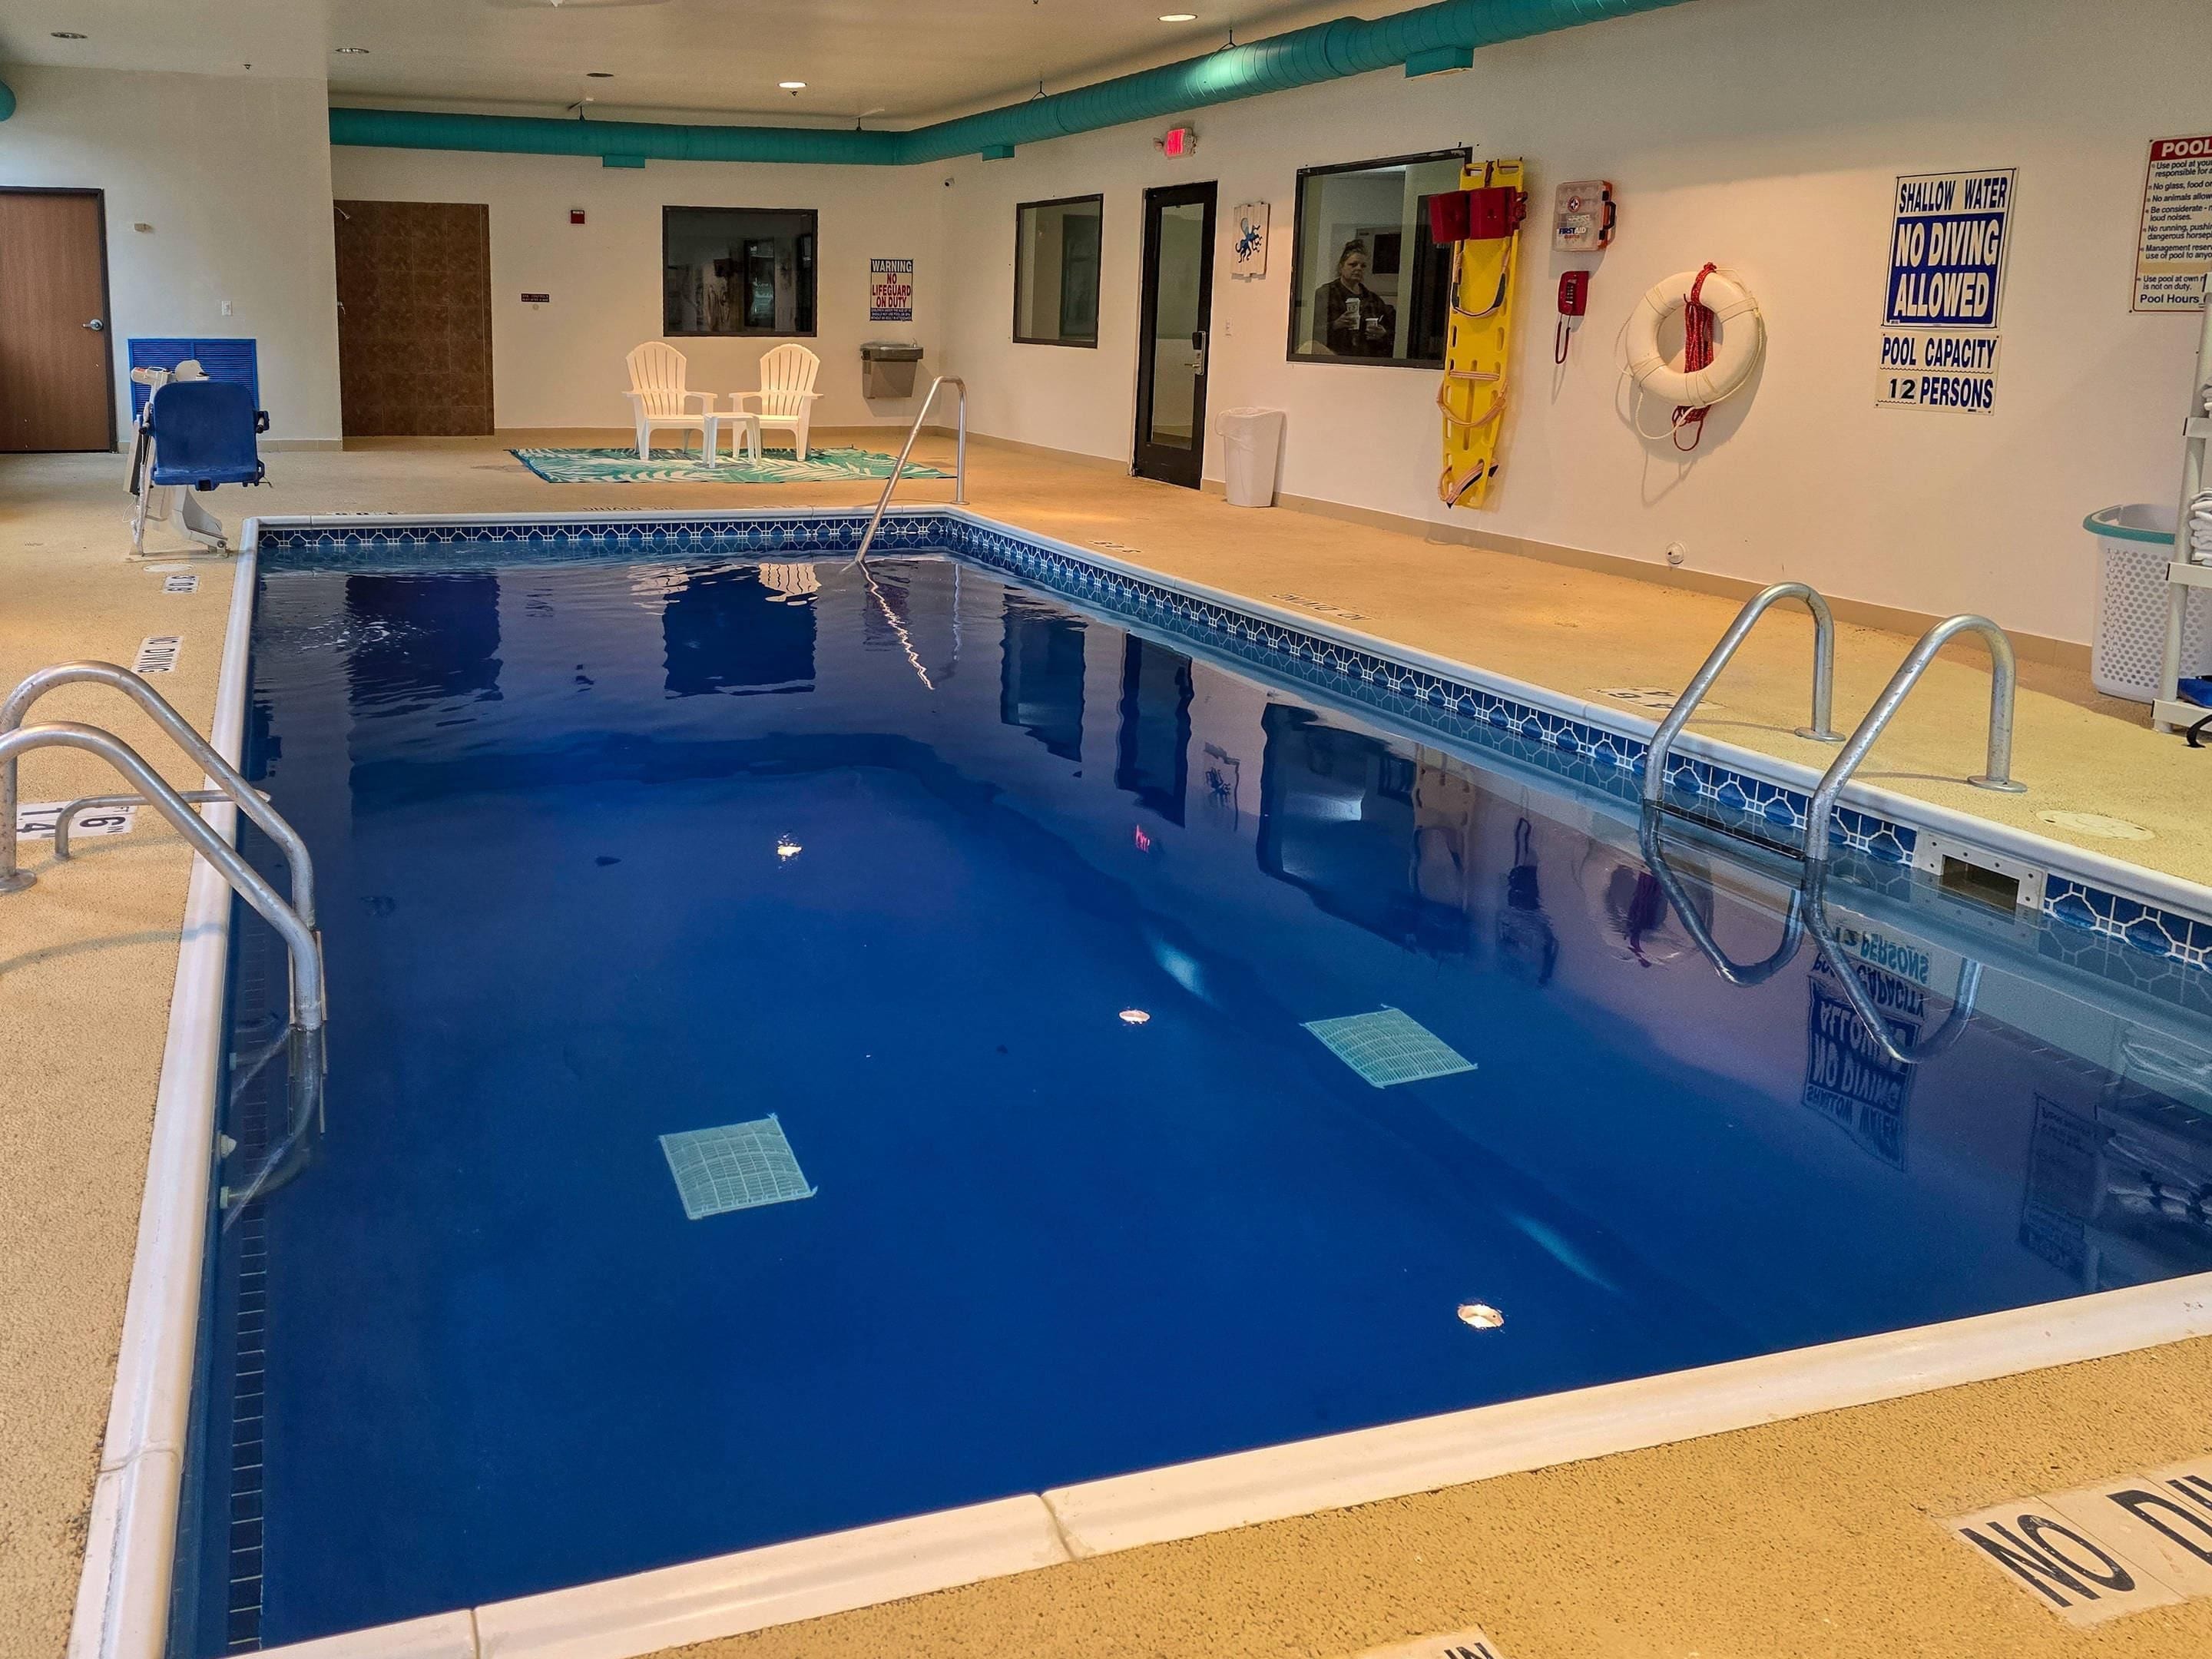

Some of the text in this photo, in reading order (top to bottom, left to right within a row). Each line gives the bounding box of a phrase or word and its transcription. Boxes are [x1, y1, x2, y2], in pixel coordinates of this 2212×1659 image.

[2161, 139, 2212, 157] POOL
[2171, 161, 2187, 170] pool
[2155, 169, 2196, 178] responsible
[1899, 177, 2008, 213] SHALLOW WATER
[2147, 233, 2184, 241] dangerous
[1896, 220, 1999, 267] NO DIVING
[2146, 244, 2190, 253] Management
[2169, 252, 2184, 260] pool
[872, 260, 912, 272] WARNING
[887, 273, 897, 284] NO
[873, 285, 911, 296] LIFEGUARD
[1893, 272, 1990, 317] ALLOWED
[876, 296, 906, 307] ON DUTY
[2140, 294, 2200, 303] Pool Hours
[1882, 336, 1997, 369] POOL CAPACITY
[1890, 376, 1994, 409] 12 PERSONS
[137, 648, 176, 673] DIVING
[80, 816, 126, 828] 6
[1959, 1514, 2136, 1608] NO
